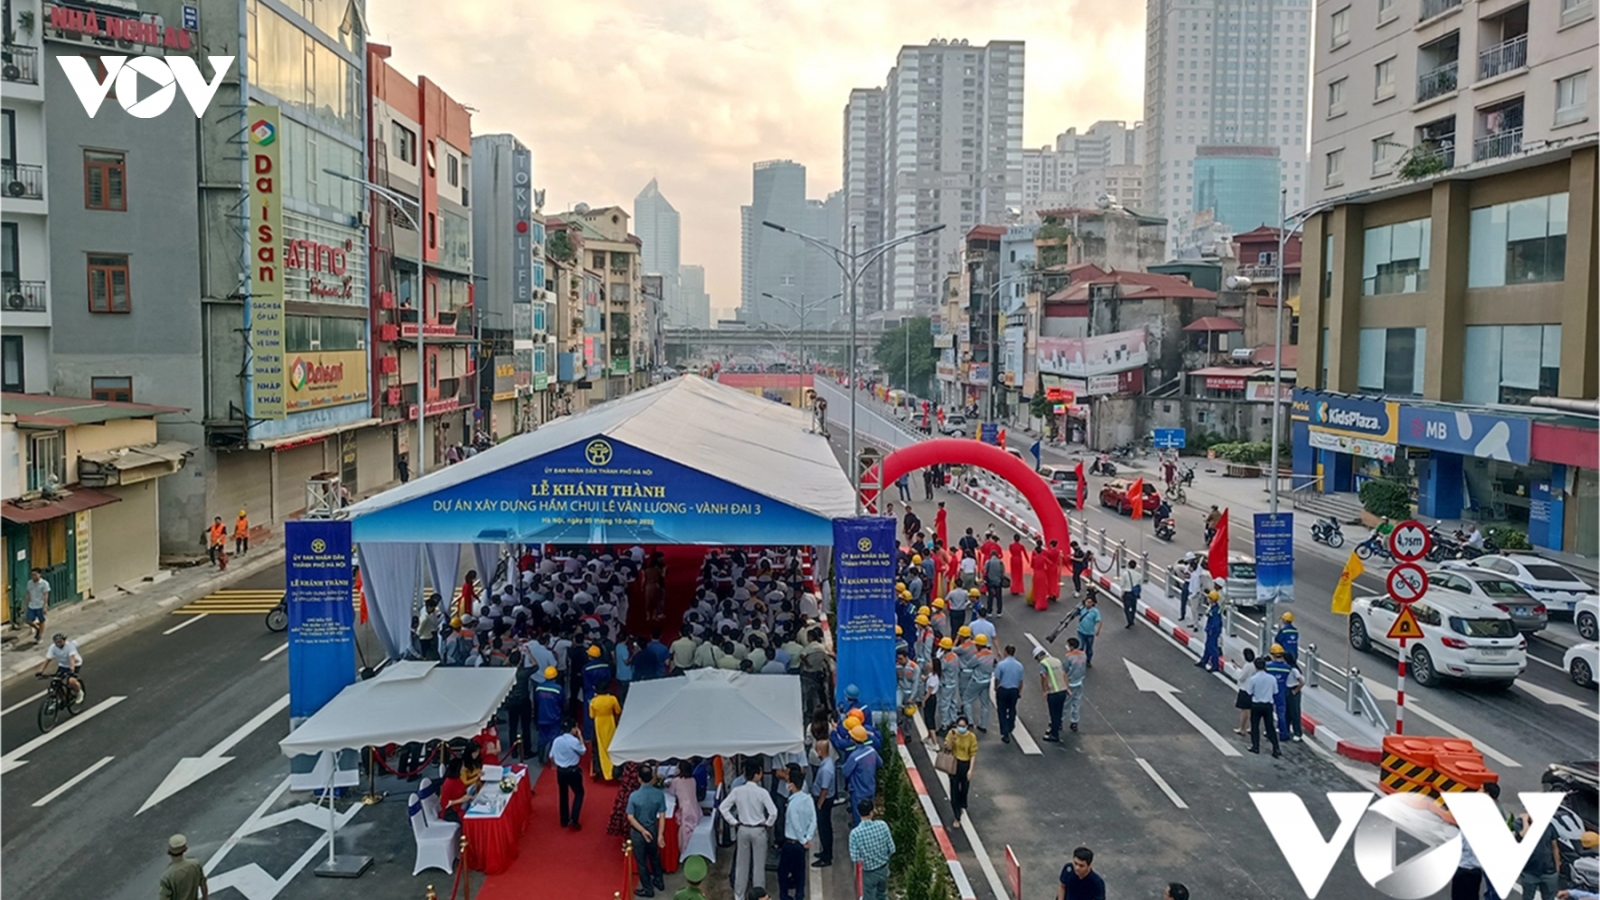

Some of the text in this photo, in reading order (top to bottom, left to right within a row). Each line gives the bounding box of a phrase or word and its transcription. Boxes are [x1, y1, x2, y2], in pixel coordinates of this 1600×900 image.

[51, 6, 99, 35] NHÀ
[1425, 420, 1447, 440] MB
[619, 467, 632, 475] PHỐ
[531, 479, 665, 498] LỄ KHÁNH THÀNH
[433, 499, 452, 513] DỰ
[454, 498, 472, 511] ÁN
[475, 498, 498, 511] XÂY
[500, 499, 537, 513] DỰNG
[539, 498, 568, 511] HẦM
[570, 501, 600, 512] CHUI
[602, 499, 615, 512] LÊ
[617, 499, 642, 512] VĂN
[644, 501, 687, 514] LƯƠNG
[695, 501, 729, 514] VÀNH
[731, 503, 752, 514] ĐAI
[754, 504, 762, 515] 3
